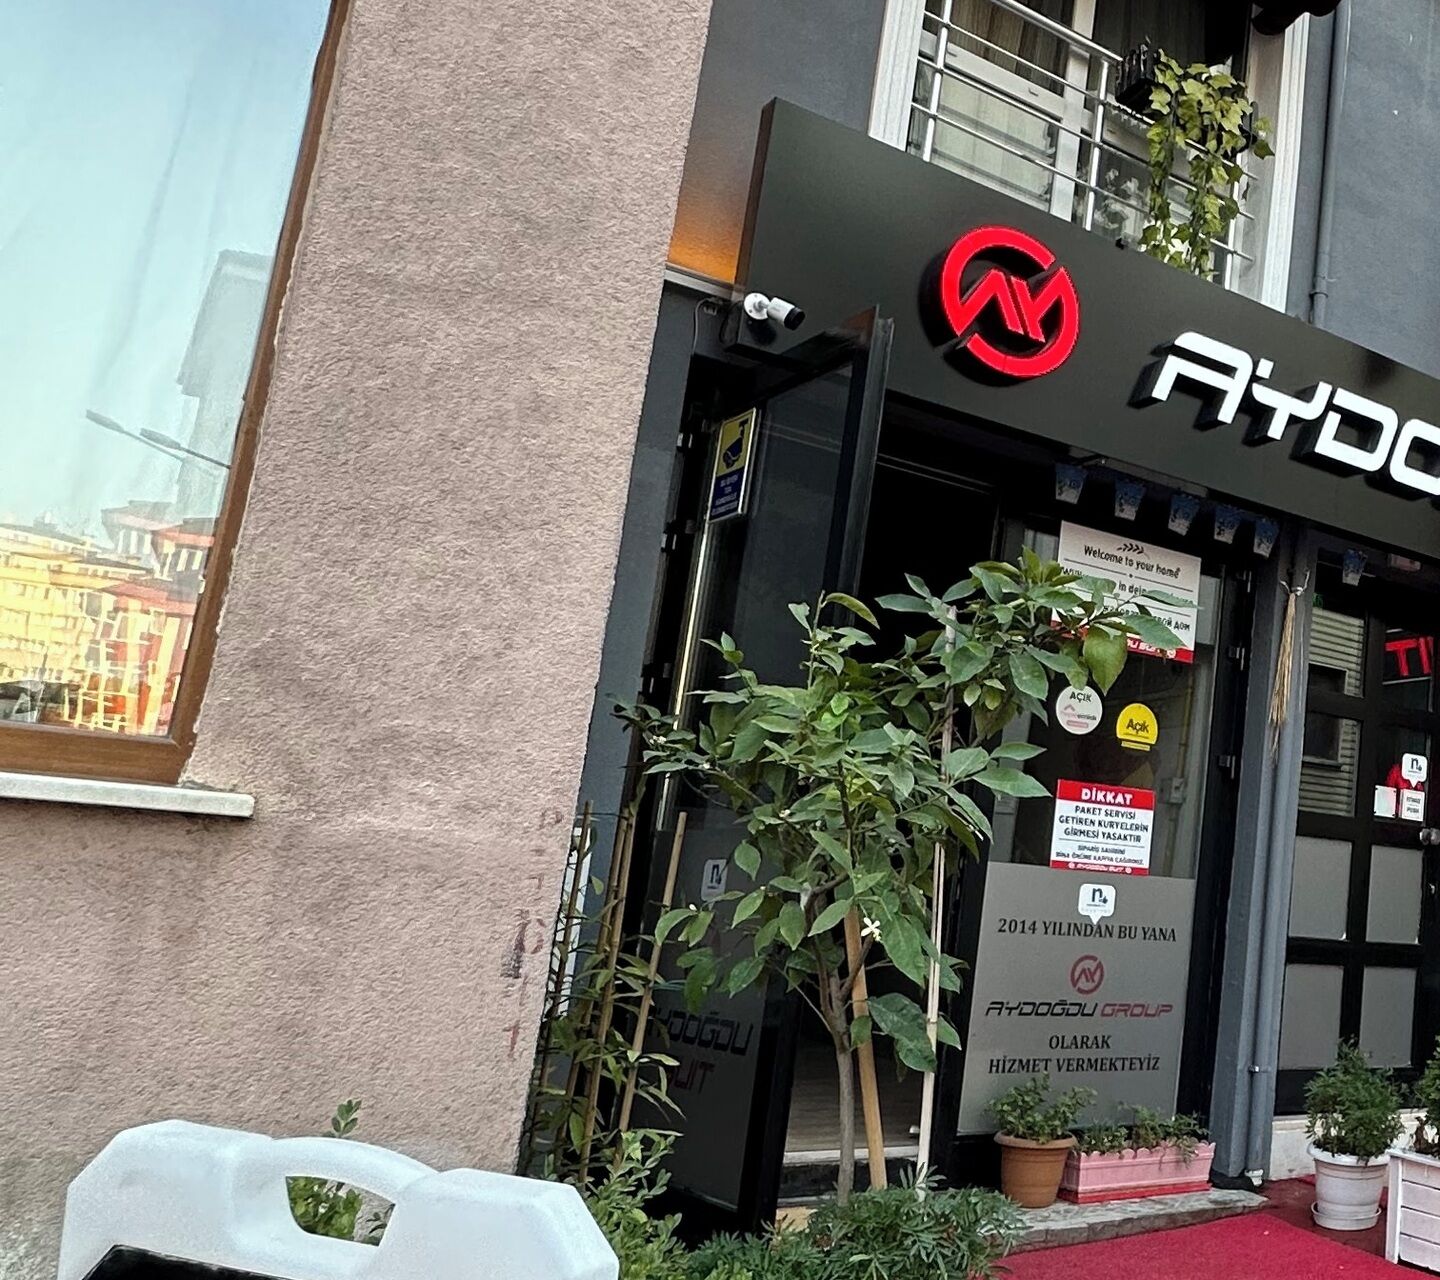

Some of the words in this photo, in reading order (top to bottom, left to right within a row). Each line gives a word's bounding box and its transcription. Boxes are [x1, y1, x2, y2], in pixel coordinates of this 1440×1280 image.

[1084, 545, 1123, 565] Welcome
[1125, 557, 1134, 567] to
[1136, 560, 1155, 571] your
[1081, 788, 1133, 805] DİKKAT
[1075, 805, 1102, 816] PAKET
[1104, 808, 1136, 819] SERVİSİ
[1058, 815, 1096, 827] GETİREN
[1064, 826, 1099, 838] GİRMESİ
[1102, 832, 1142, 843] YASAKTIR
[998, 918, 1037, 935] 2014
[1041, 920, 1114, 939] YILINDAN
[1118, 925, 1137, 940] BU
[1142, 927, 1176, 942] YANA
[985, 999, 1098, 1017] AYDOĞDU
[1101, 1003, 1174, 1018] GROUP
[1049, 1035, 1112, 1050] OLARAK
[988, 1055, 1052, 1074] HİZMET
[1056, 1053, 1160, 1073] VERMEKTEYİZ
